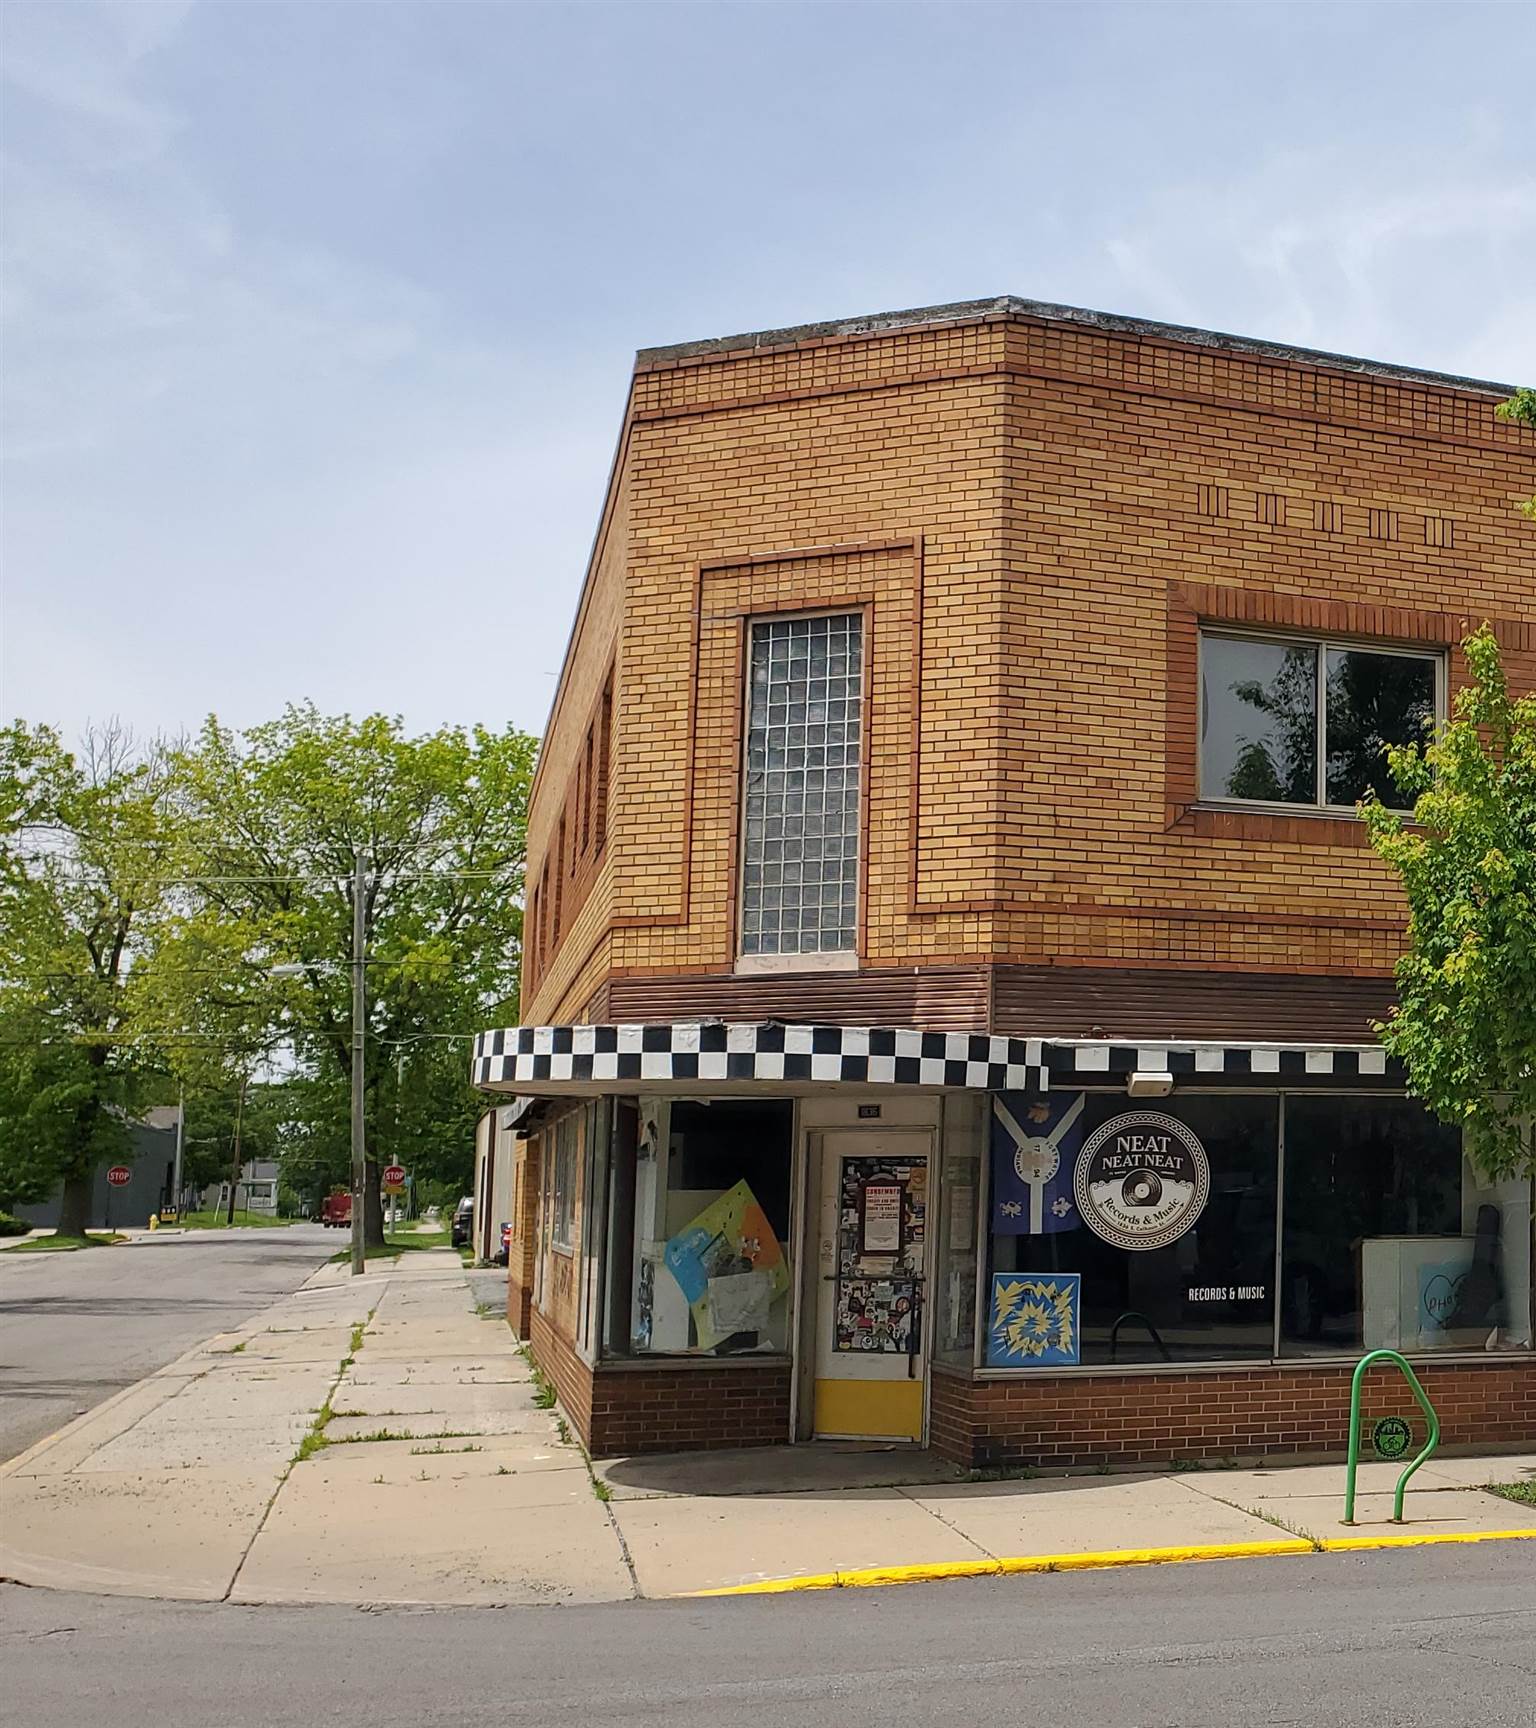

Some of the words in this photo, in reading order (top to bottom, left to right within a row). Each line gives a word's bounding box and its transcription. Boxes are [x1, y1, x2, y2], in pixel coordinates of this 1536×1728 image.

[1116, 1135, 1171, 1153] NEAT
[1102, 1154, 1142, 1170] NEAT
[1144, 1154, 1184, 1169] NEAT
[109, 1171, 130, 1182] STOP
[385, 1171, 405, 1182] STOP
[1103, 1197, 1141, 1226] Records
[1143, 1215, 1152, 1225] &
[1153, 1198, 1181, 1221] Music
[1188, 1287, 1227, 1301] RECORDS
[1229, 1287, 1235, 1300] &
[1237, 1286, 1265, 1299] MUSIC
